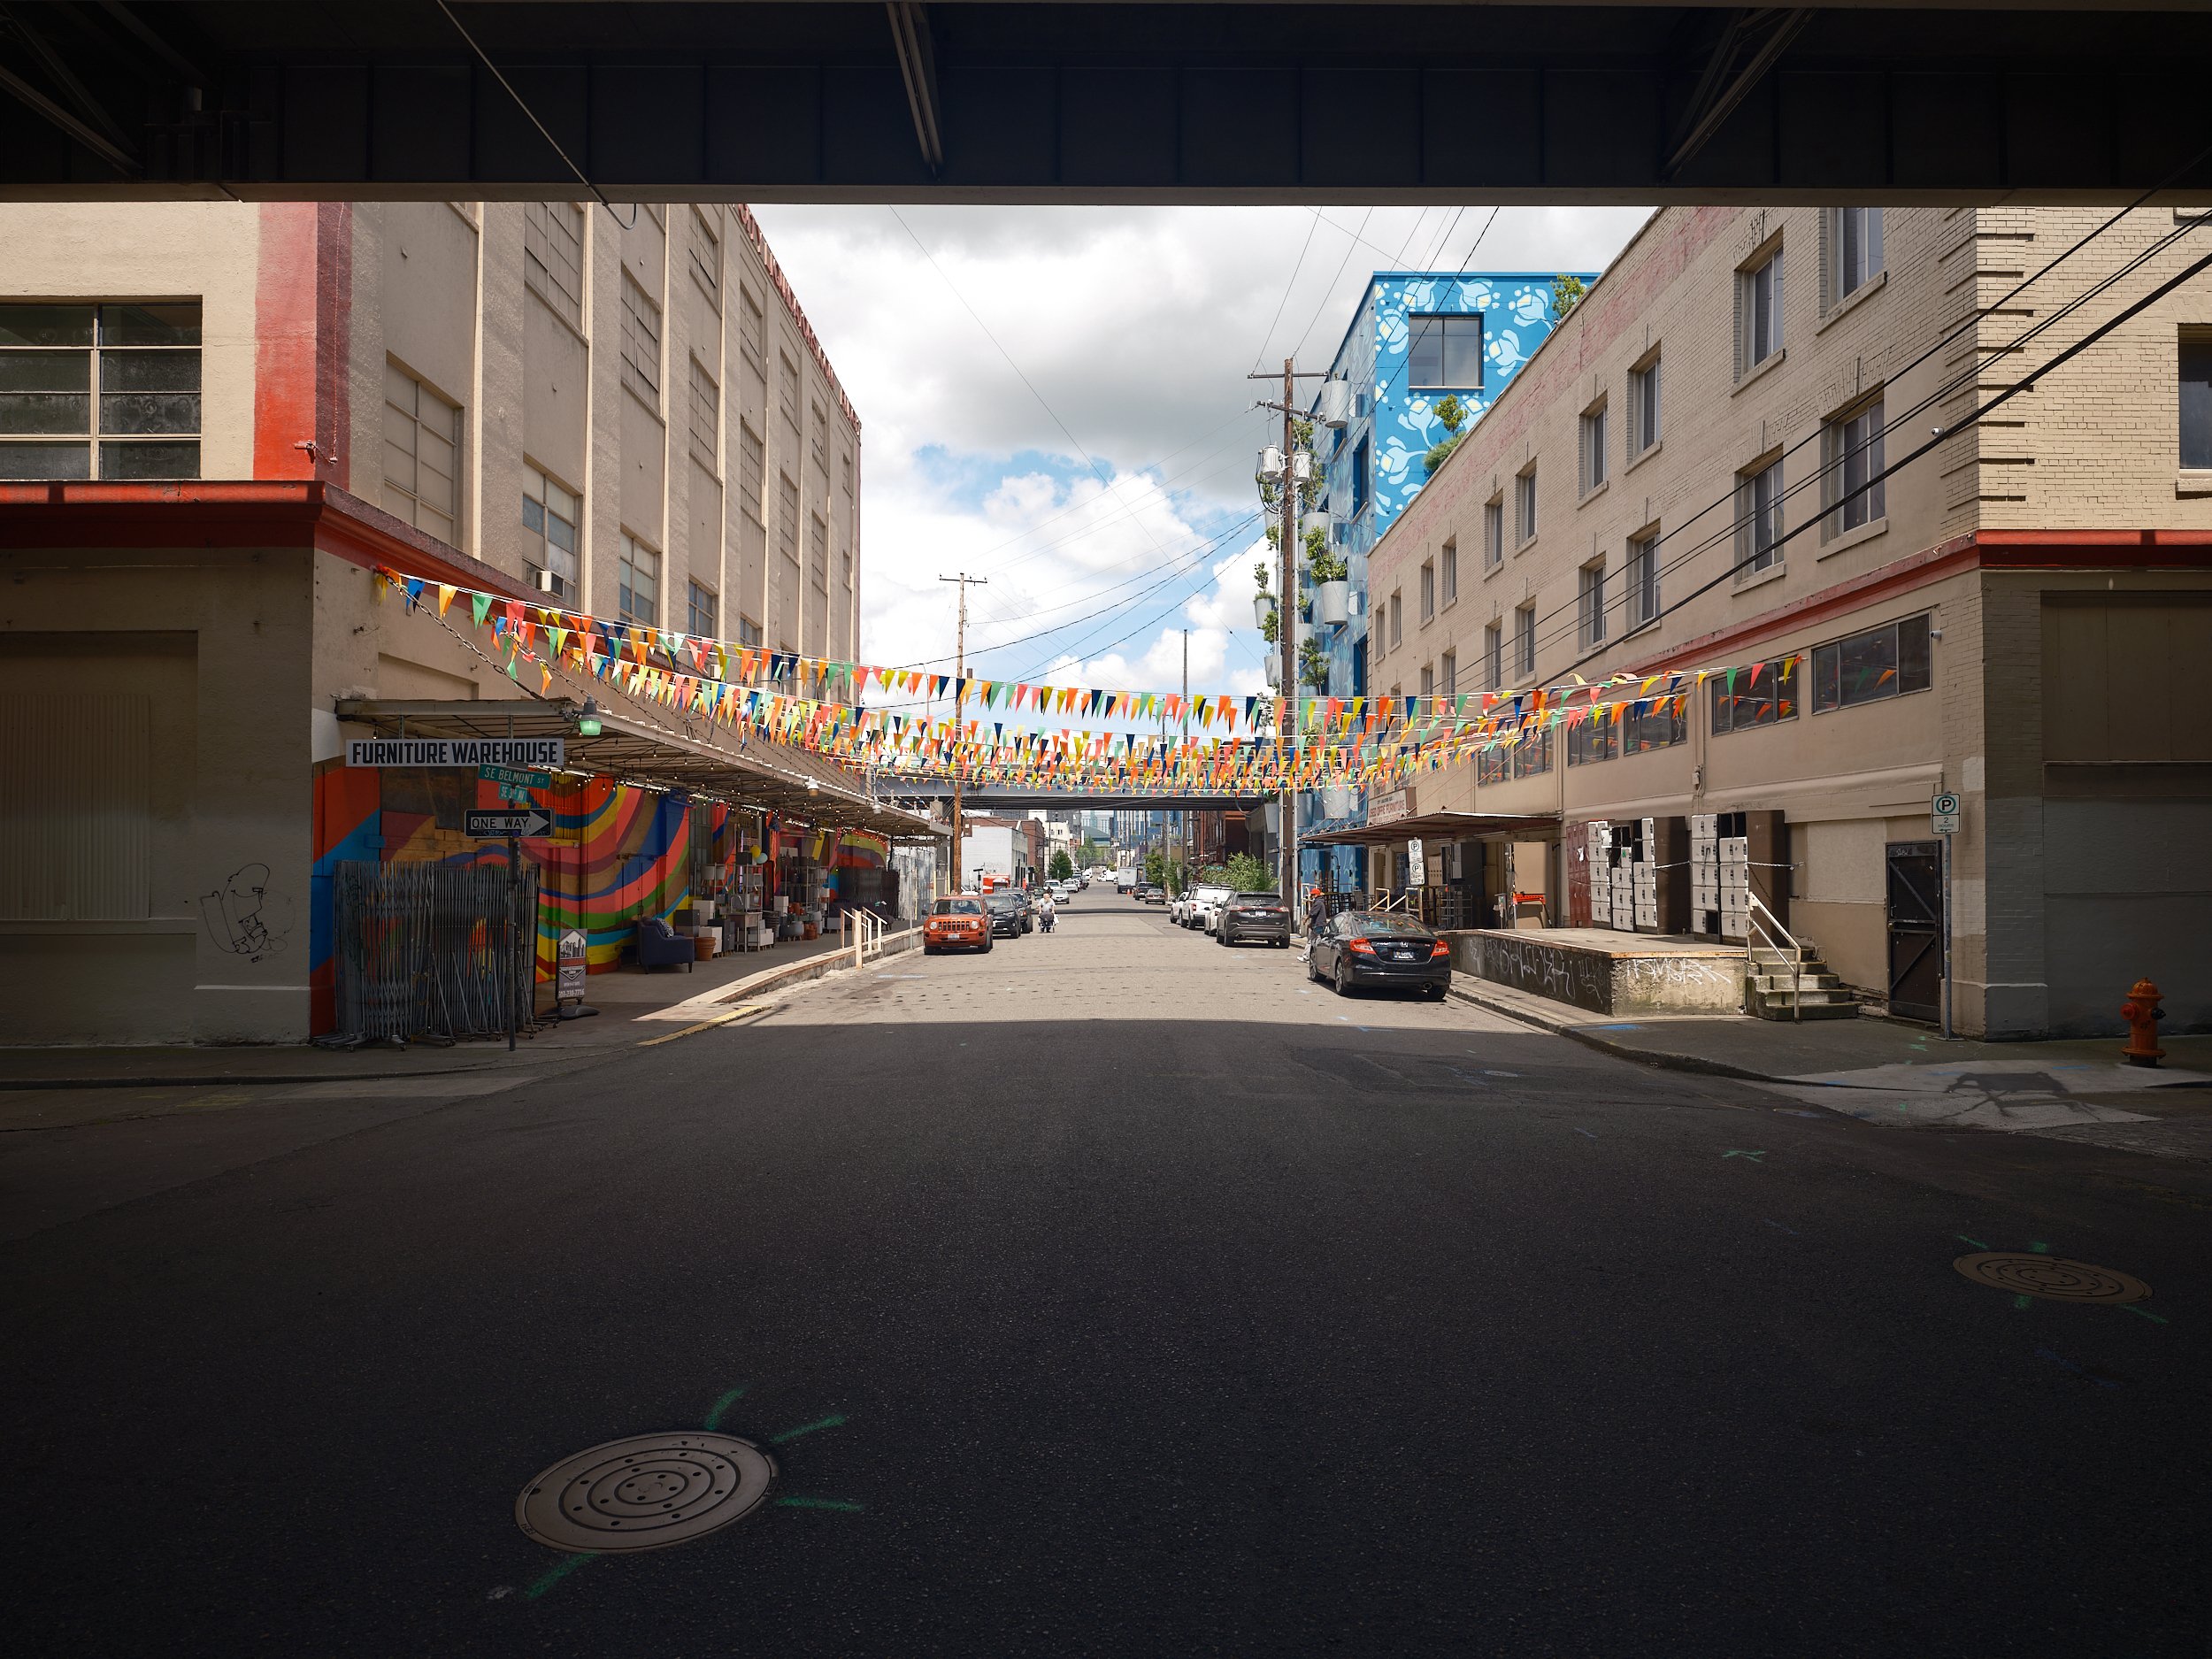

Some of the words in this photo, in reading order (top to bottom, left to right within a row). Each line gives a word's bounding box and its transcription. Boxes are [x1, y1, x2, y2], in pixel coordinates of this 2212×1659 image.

[352, 742, 448, 764] FURNITURE
[451, 741, 557, 764] WAREHOUSE
[484, 767, 496, 779] SE
[498, 769, 535, 785] BELMONT
[501, 786, 509, 798] SE
[1942, 799, 1952, 810] P
[472, 818, 496, 829] ONE
[504, 818, 529, 828] WAY
